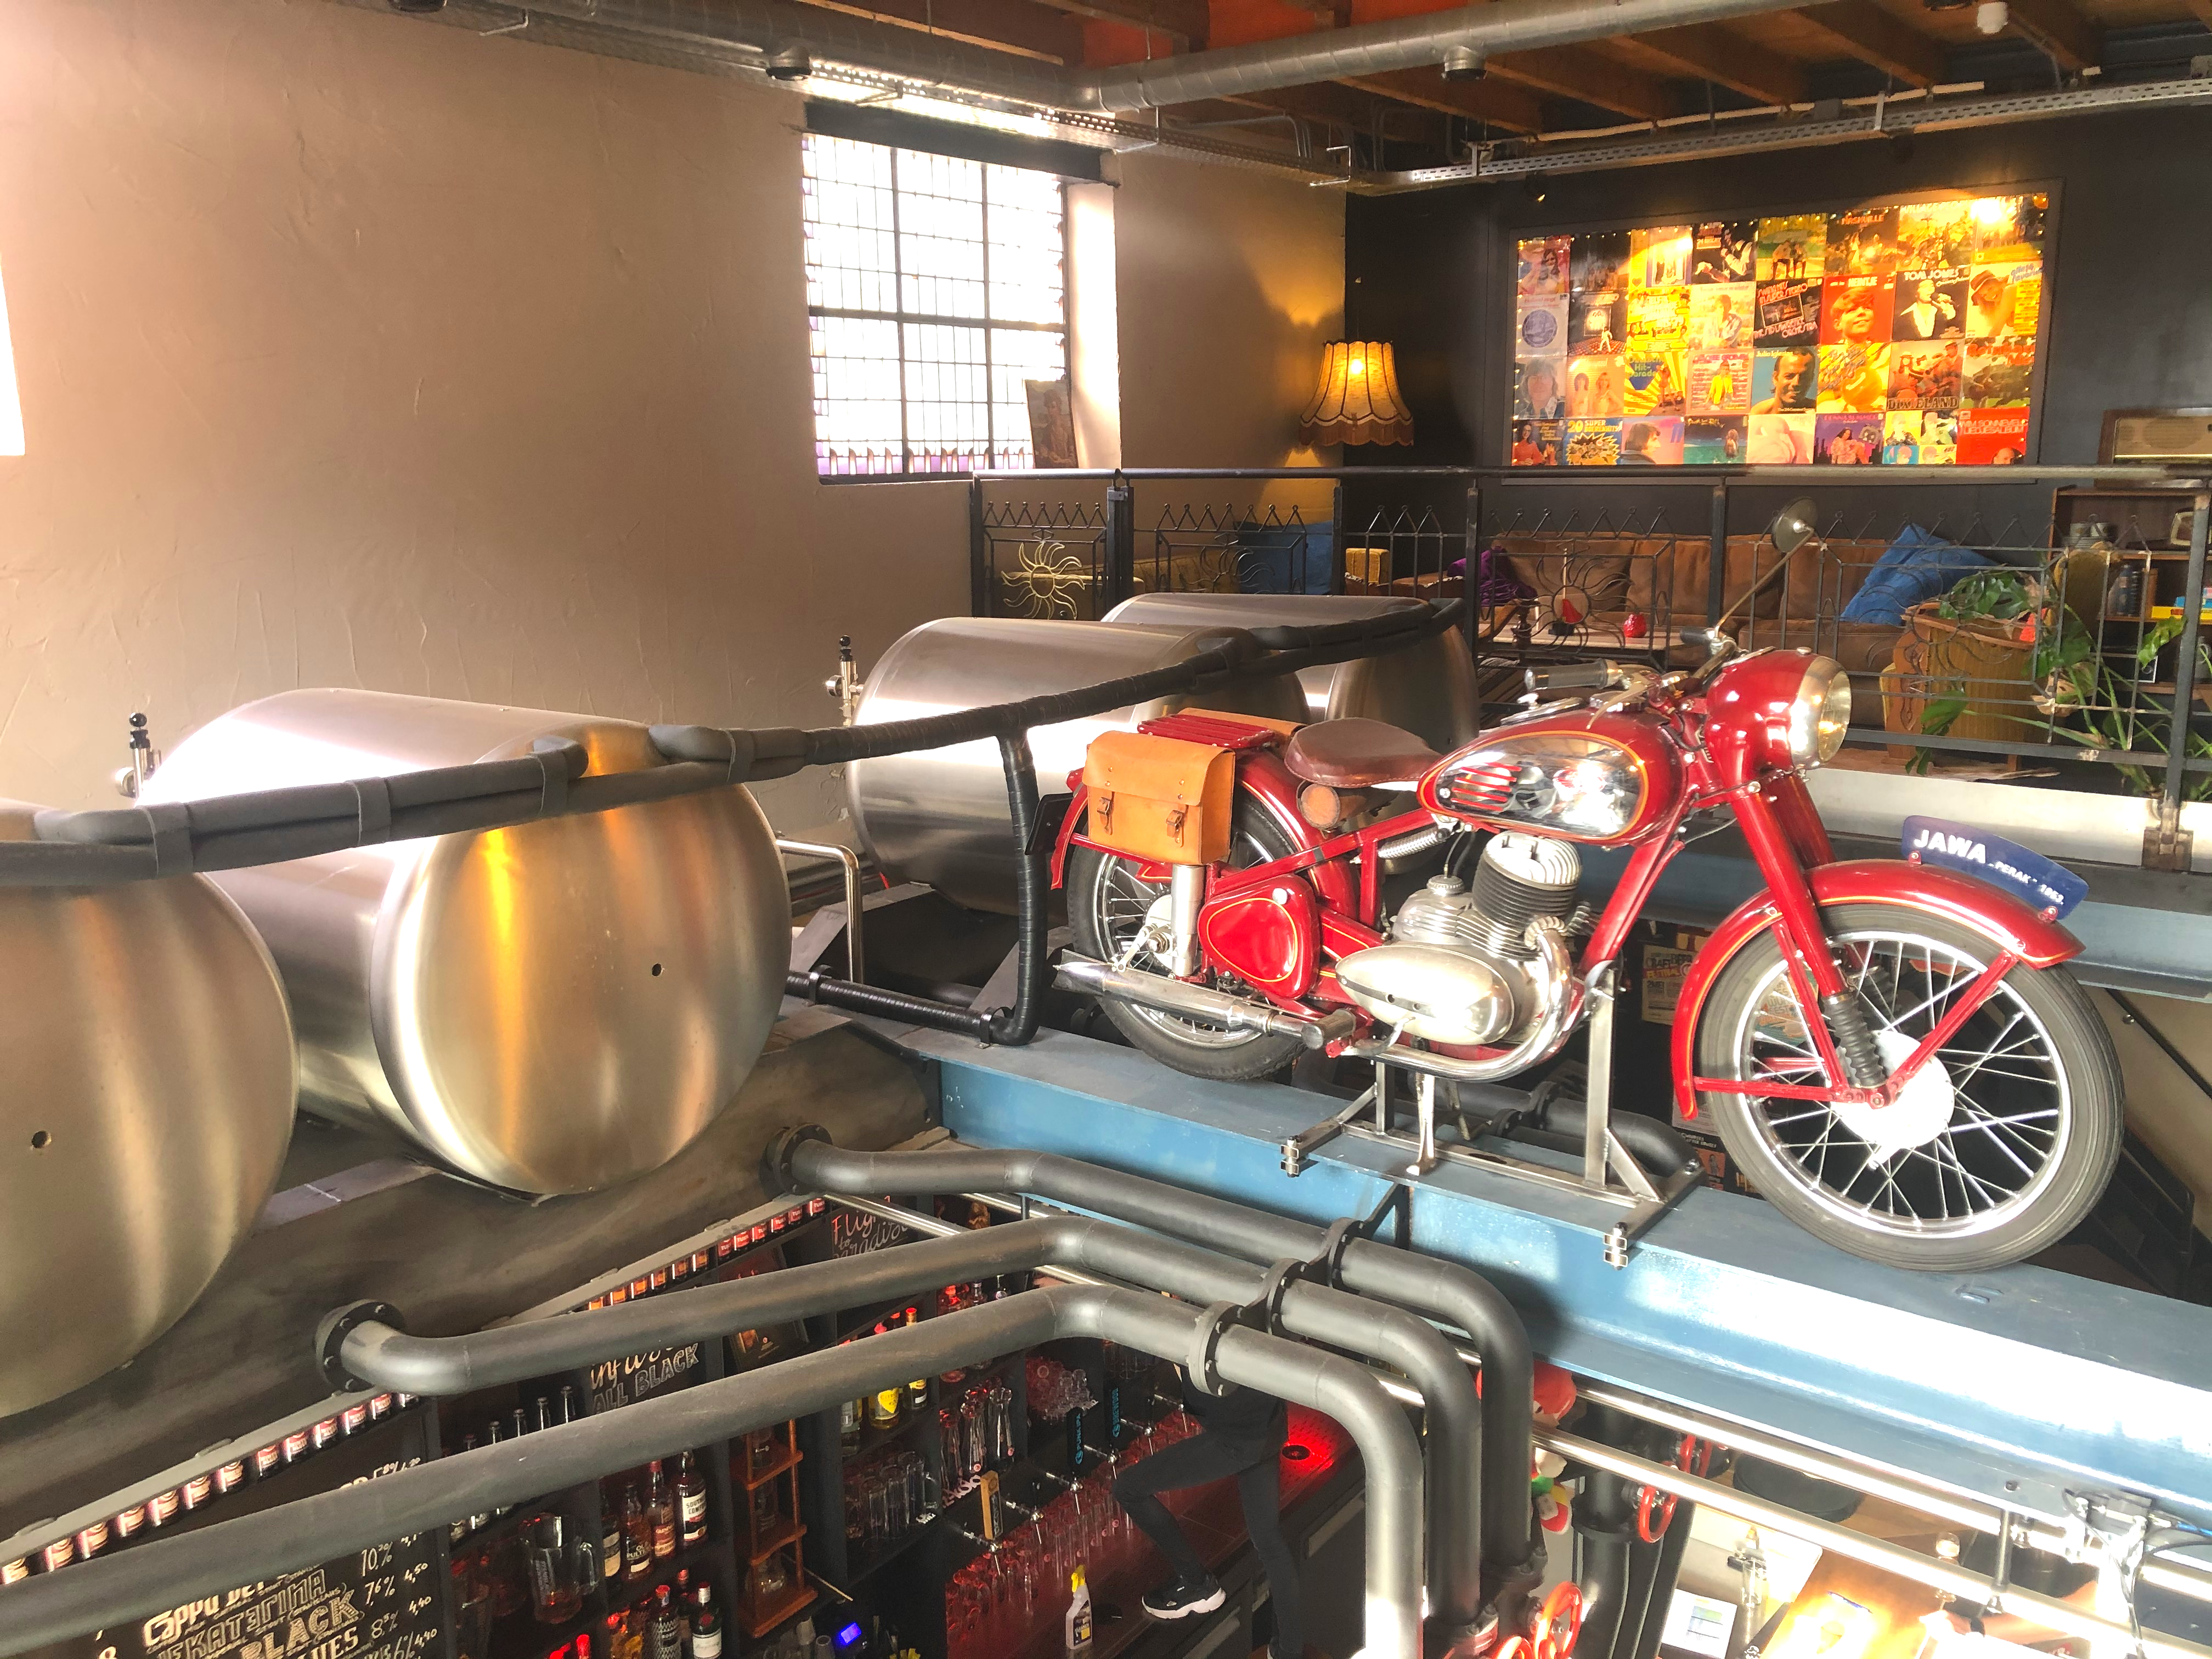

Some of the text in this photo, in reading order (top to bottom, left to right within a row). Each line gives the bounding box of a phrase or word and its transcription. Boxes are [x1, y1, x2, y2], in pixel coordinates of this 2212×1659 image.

[1904, 268, 1959, 280] TOM JONES
[1848, 276, 1878, 287] HEINTJE
[1888, 397, 1959, 409] DIXIELAND
[1567, 420, 1584, 433] 20
[1978, 419, 2028, 427] SONNEVEL
[1914, 829, 1987, 864] JAWA
[592, 1342, 699, 1413] ALL BLACK
